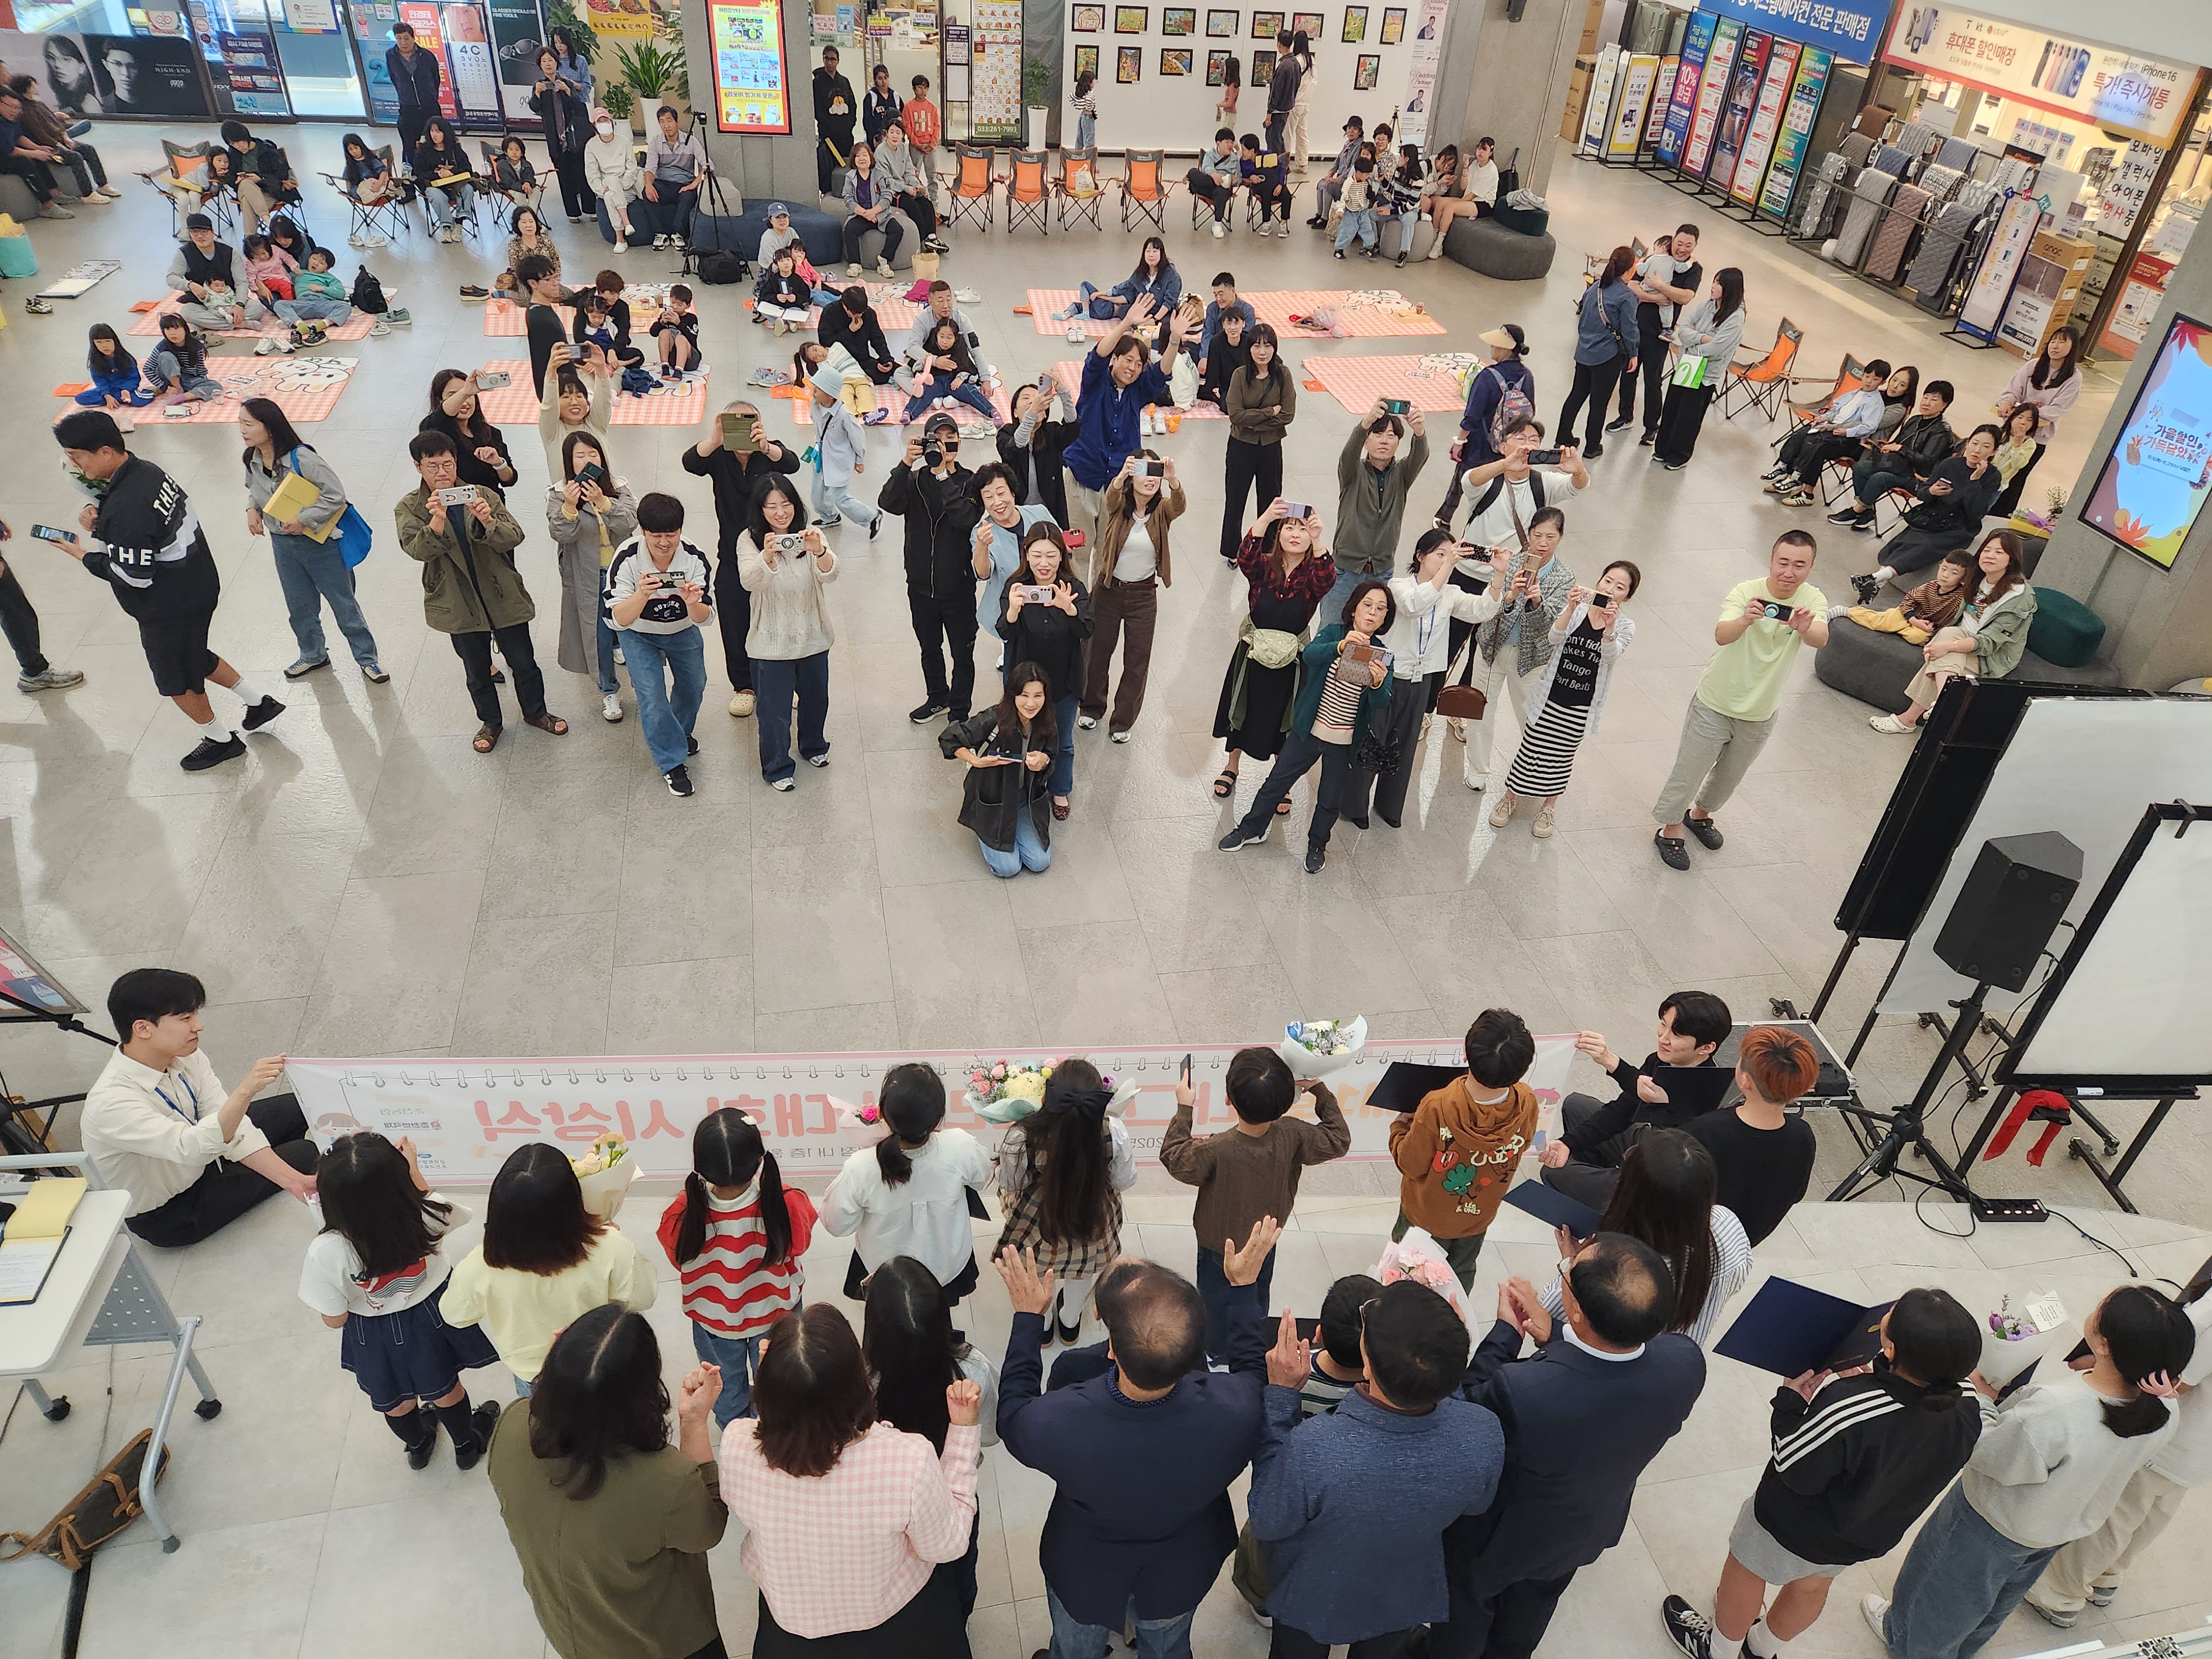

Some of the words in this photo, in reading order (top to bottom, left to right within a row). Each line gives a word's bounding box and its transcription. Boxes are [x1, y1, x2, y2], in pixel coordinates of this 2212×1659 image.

[1811, 4, 1834, 29] 전문
[1833, 11, 1872, 41] 판매점
[1975, 22, 1984, 32] kt
[414, 36, 439, 49] SALE
[460, 45, 468, 55] 4
[1946, 32, 1977, 54] 휴대폰
[1976, 39, 2017, 66] 할인매장
[2103, 56, 2119, 66] 완전히
[1410, 70, 1436, 79] Wedding
[1681, 65, 1698, 87] 10%
[1676, 84, 1691, 104] 환급
[2093, 72, 2122, 95] 특가!
[2121, 79, 2171, 109] 즉시개통
[2129, 139, 2164, 164] 모바일
[2121, 160, 2155, 182] 갤럭시
[2112, 183, 2144, 207] 아이폰
[2154, 424, 2199, 448] 가을할인
[1566, 636, 1585, 646] on't
[1563, 645, 1586, 658] akes
[1588, 652, 1600, 664] Tw
[1562, 659, 1592, 676] Tango
[1556, 672, 1569, 686] eart
[1568, 679, 1591, 691] Beats
[1464, 1201, 1477, 1209] LÉG
